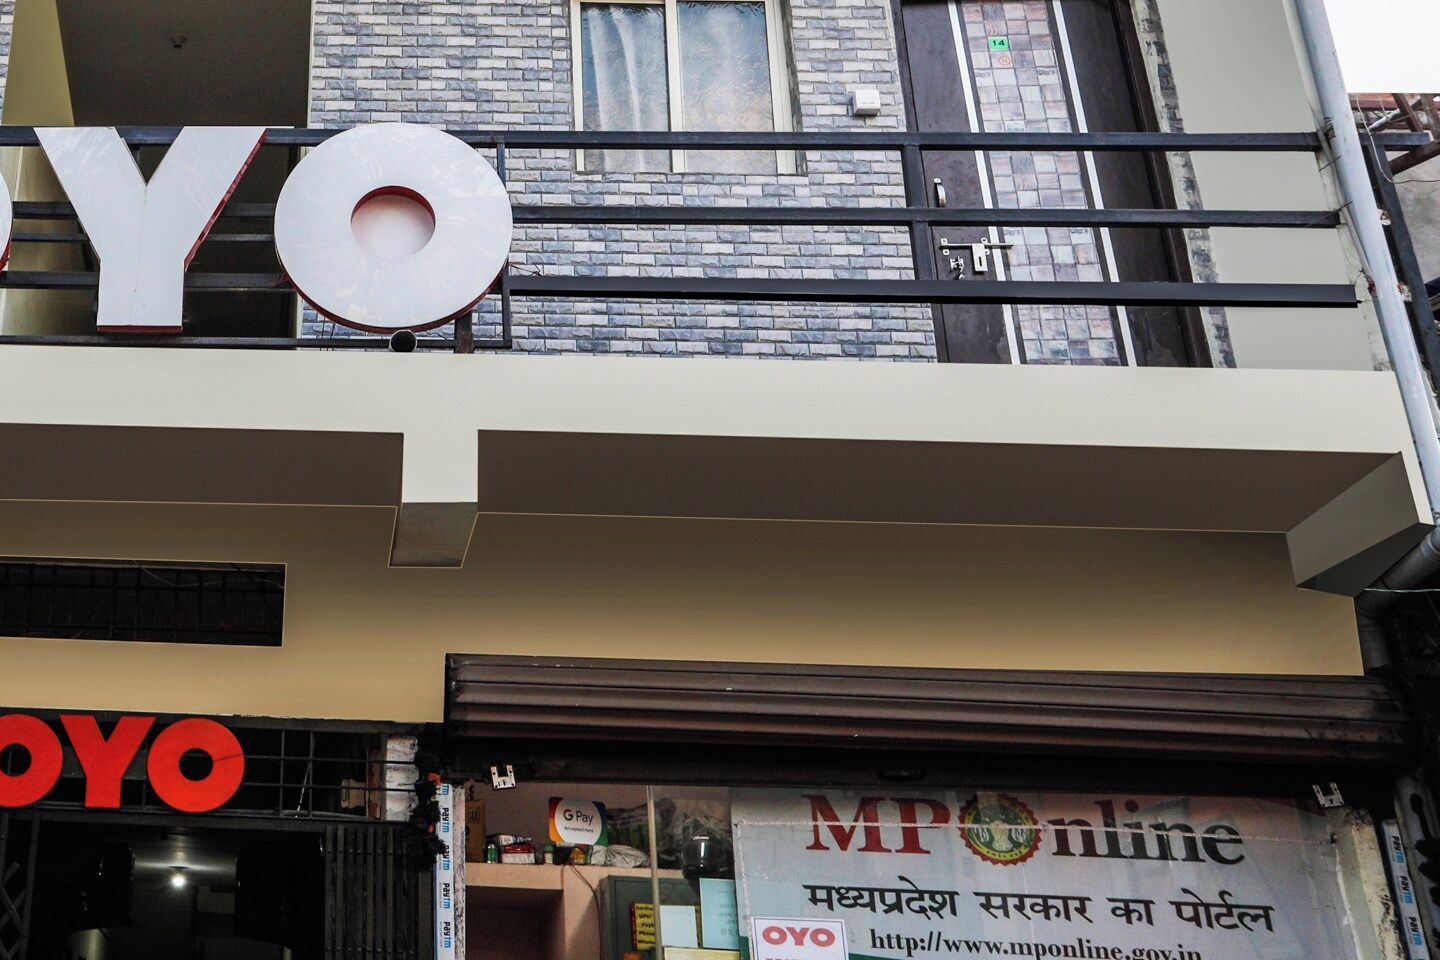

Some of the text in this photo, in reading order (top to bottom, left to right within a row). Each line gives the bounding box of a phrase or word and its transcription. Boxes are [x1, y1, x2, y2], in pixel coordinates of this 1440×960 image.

[563, 808, 593, 825] G Pay
[803, 793, 950, 854] MP
[803, 876, 1276, 932] मध्यप्रदेश सरकार का पोर्टल
[762, 926, 835, 947] OYO
